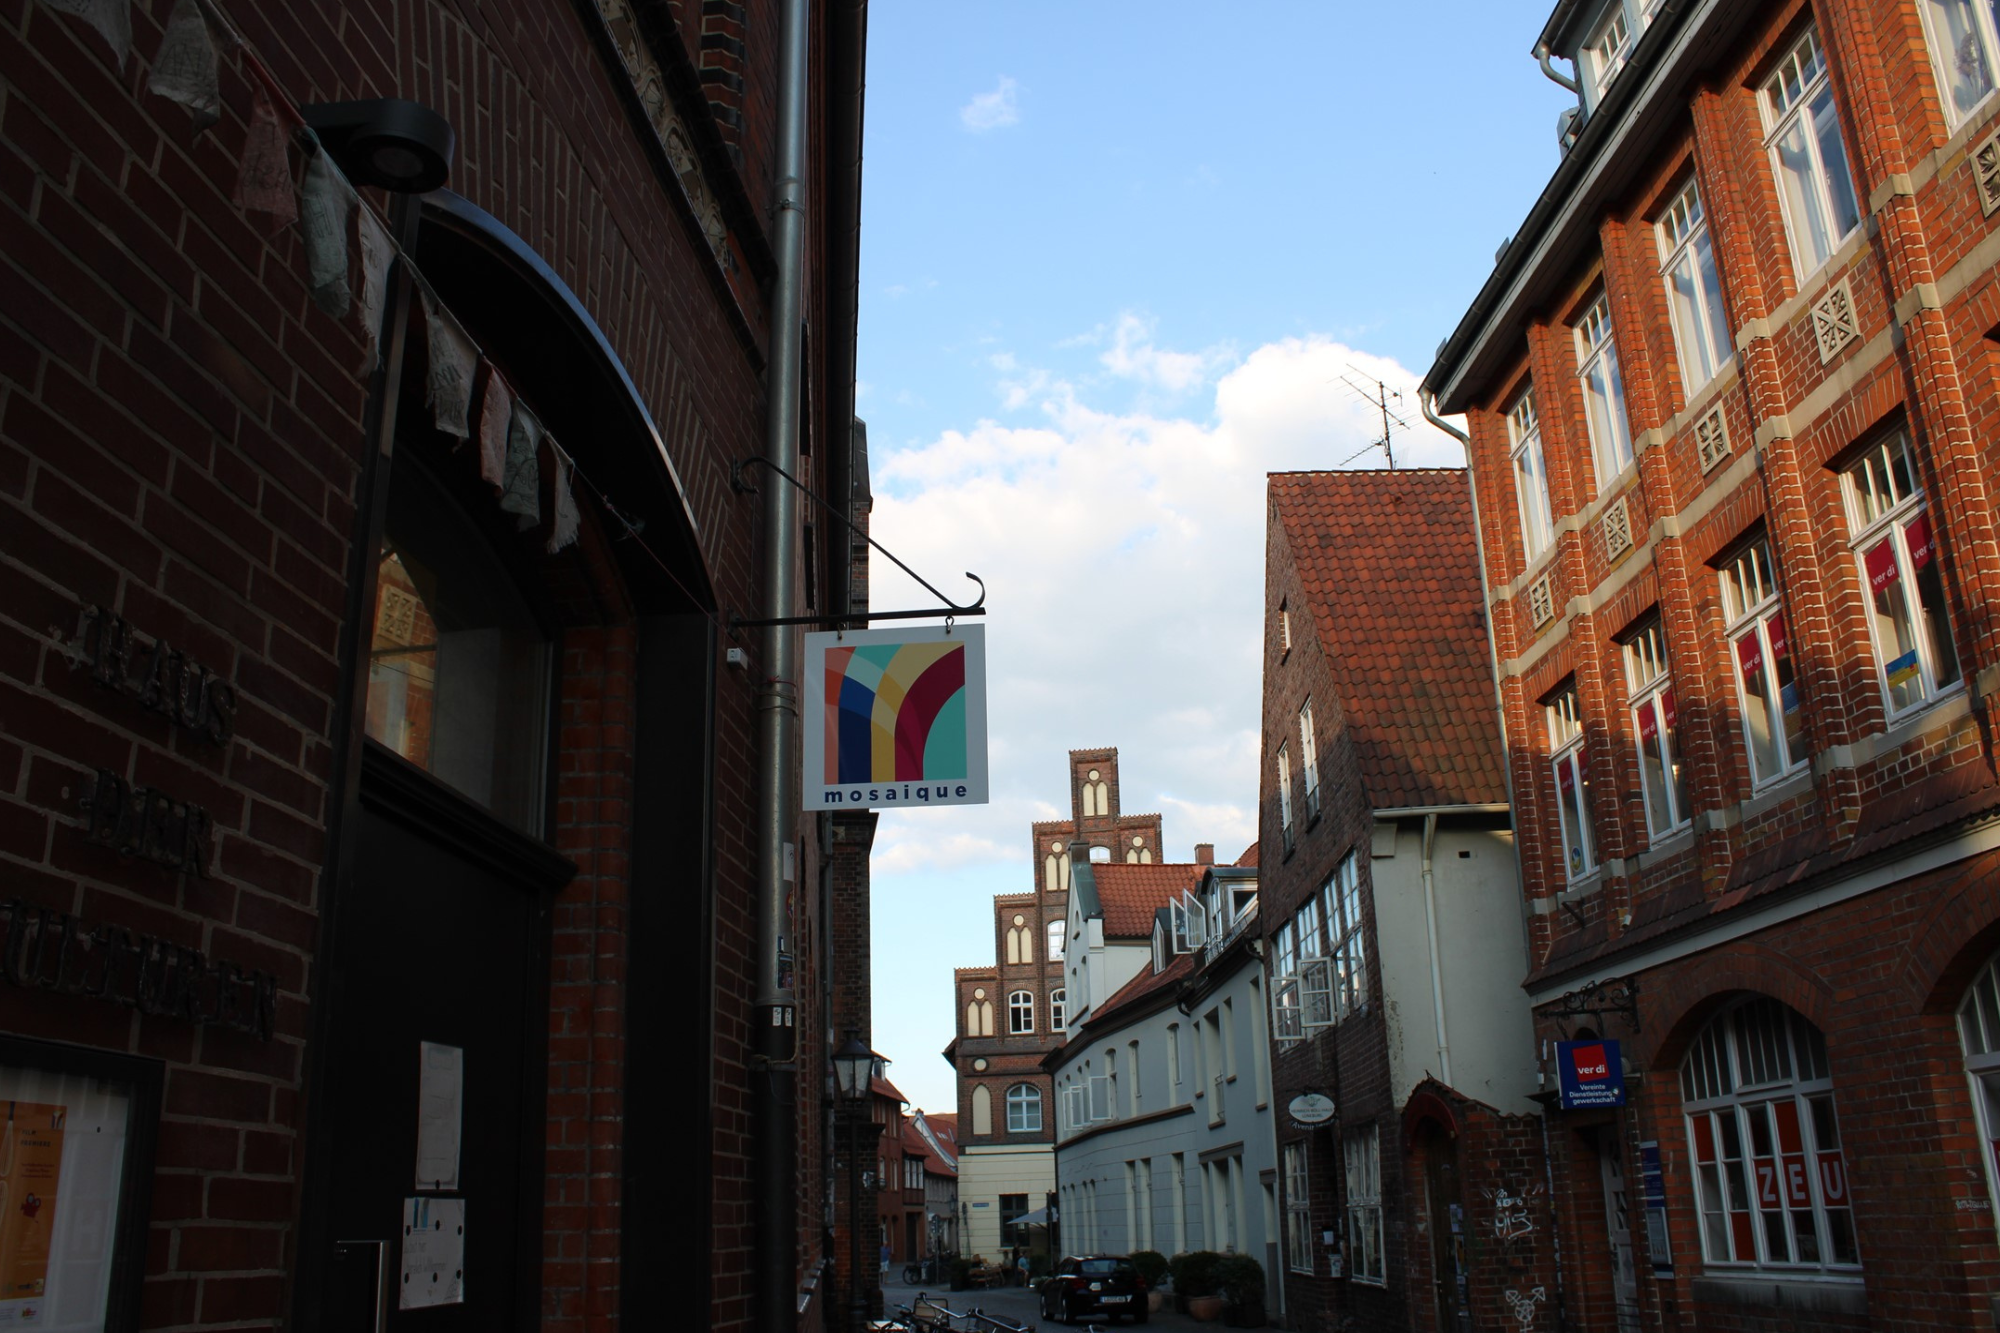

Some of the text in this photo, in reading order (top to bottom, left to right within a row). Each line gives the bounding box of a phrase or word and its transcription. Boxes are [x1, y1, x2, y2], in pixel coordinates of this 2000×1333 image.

[86, 604, 237, 748] HAUS
[824, 785, 968, 803] mosaique
[1579, 1083, 1606, 1091] Vereinte
[1572, 1096, 1616, 1106] gewerkschaft
